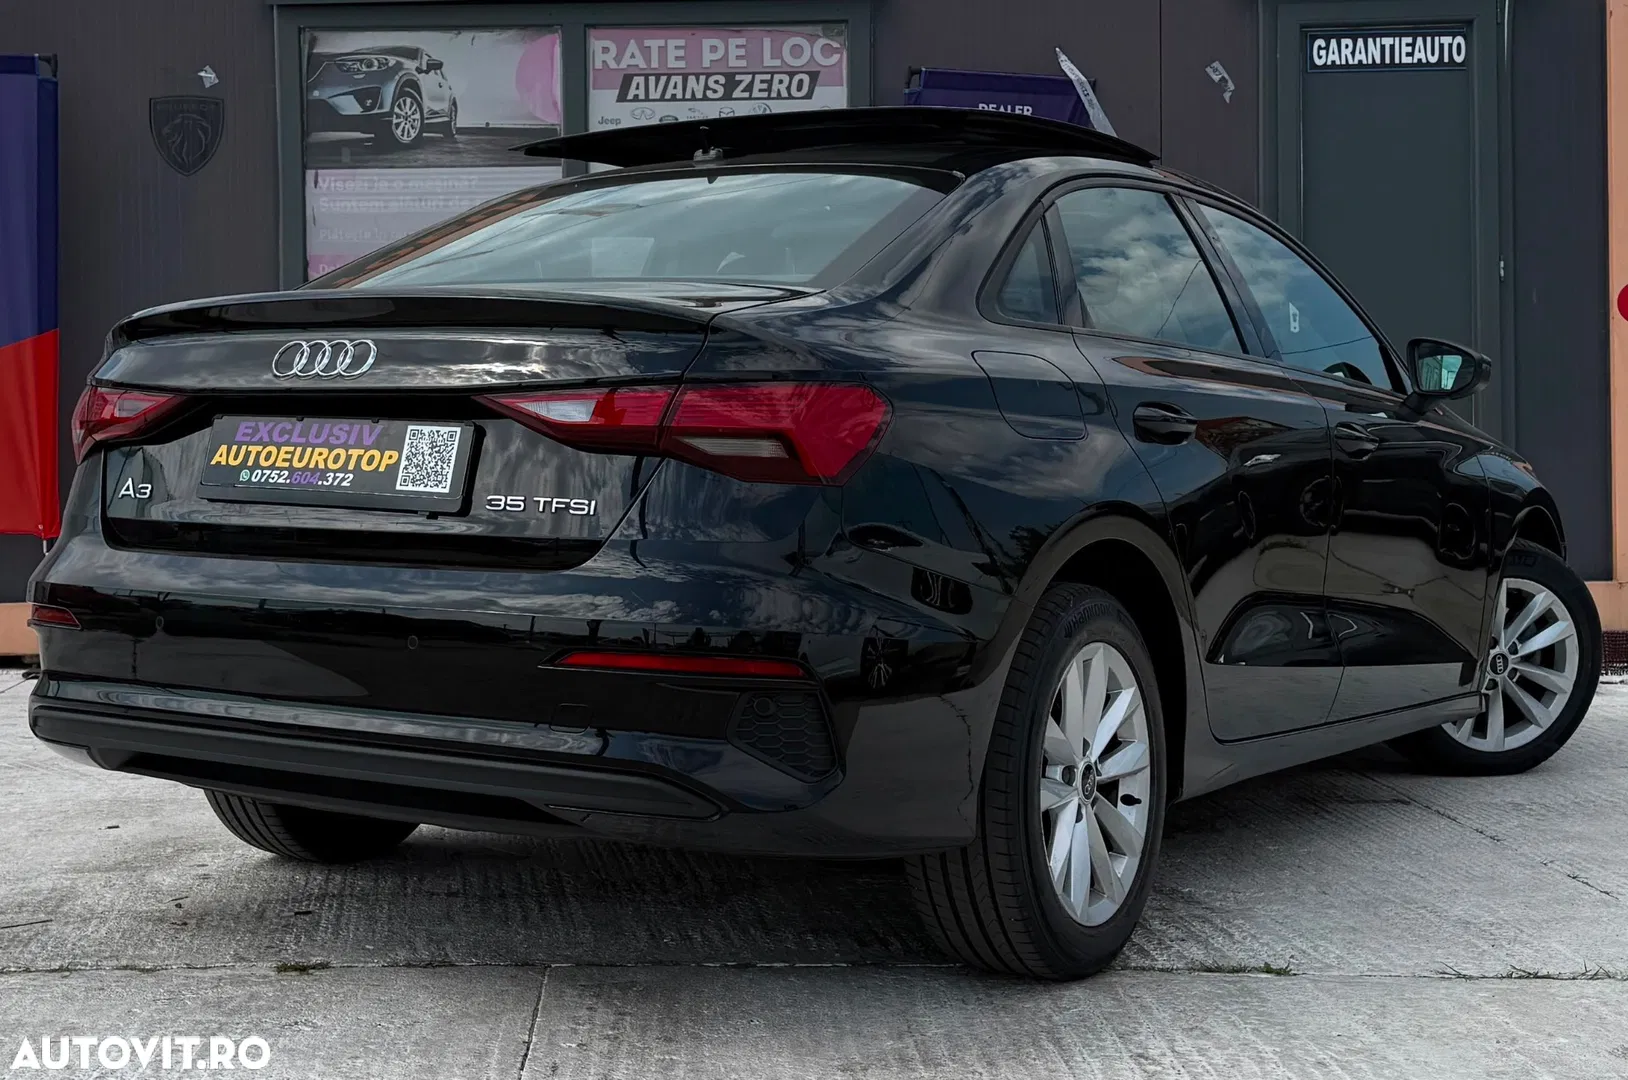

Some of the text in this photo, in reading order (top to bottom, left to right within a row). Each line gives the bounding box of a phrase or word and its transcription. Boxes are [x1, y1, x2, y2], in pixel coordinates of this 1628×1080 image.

[593, 36, 842, 69] RATE PE LOC
[1312, 35, 1466, 66] GARANTIEAUTO
[626, 73, 810, 100] AVANS ZERO
[598, 115, 622, 126] Jeep
[234, 420, 384, 446] EXCLUSIV
[210, 444, 399, 473] AUTOEUROTOP
[118, 477, 152, 499] A3
[251, 469, 354, 487] 0752.604.372
[485, 494, 597, 517] 35 TFSI
